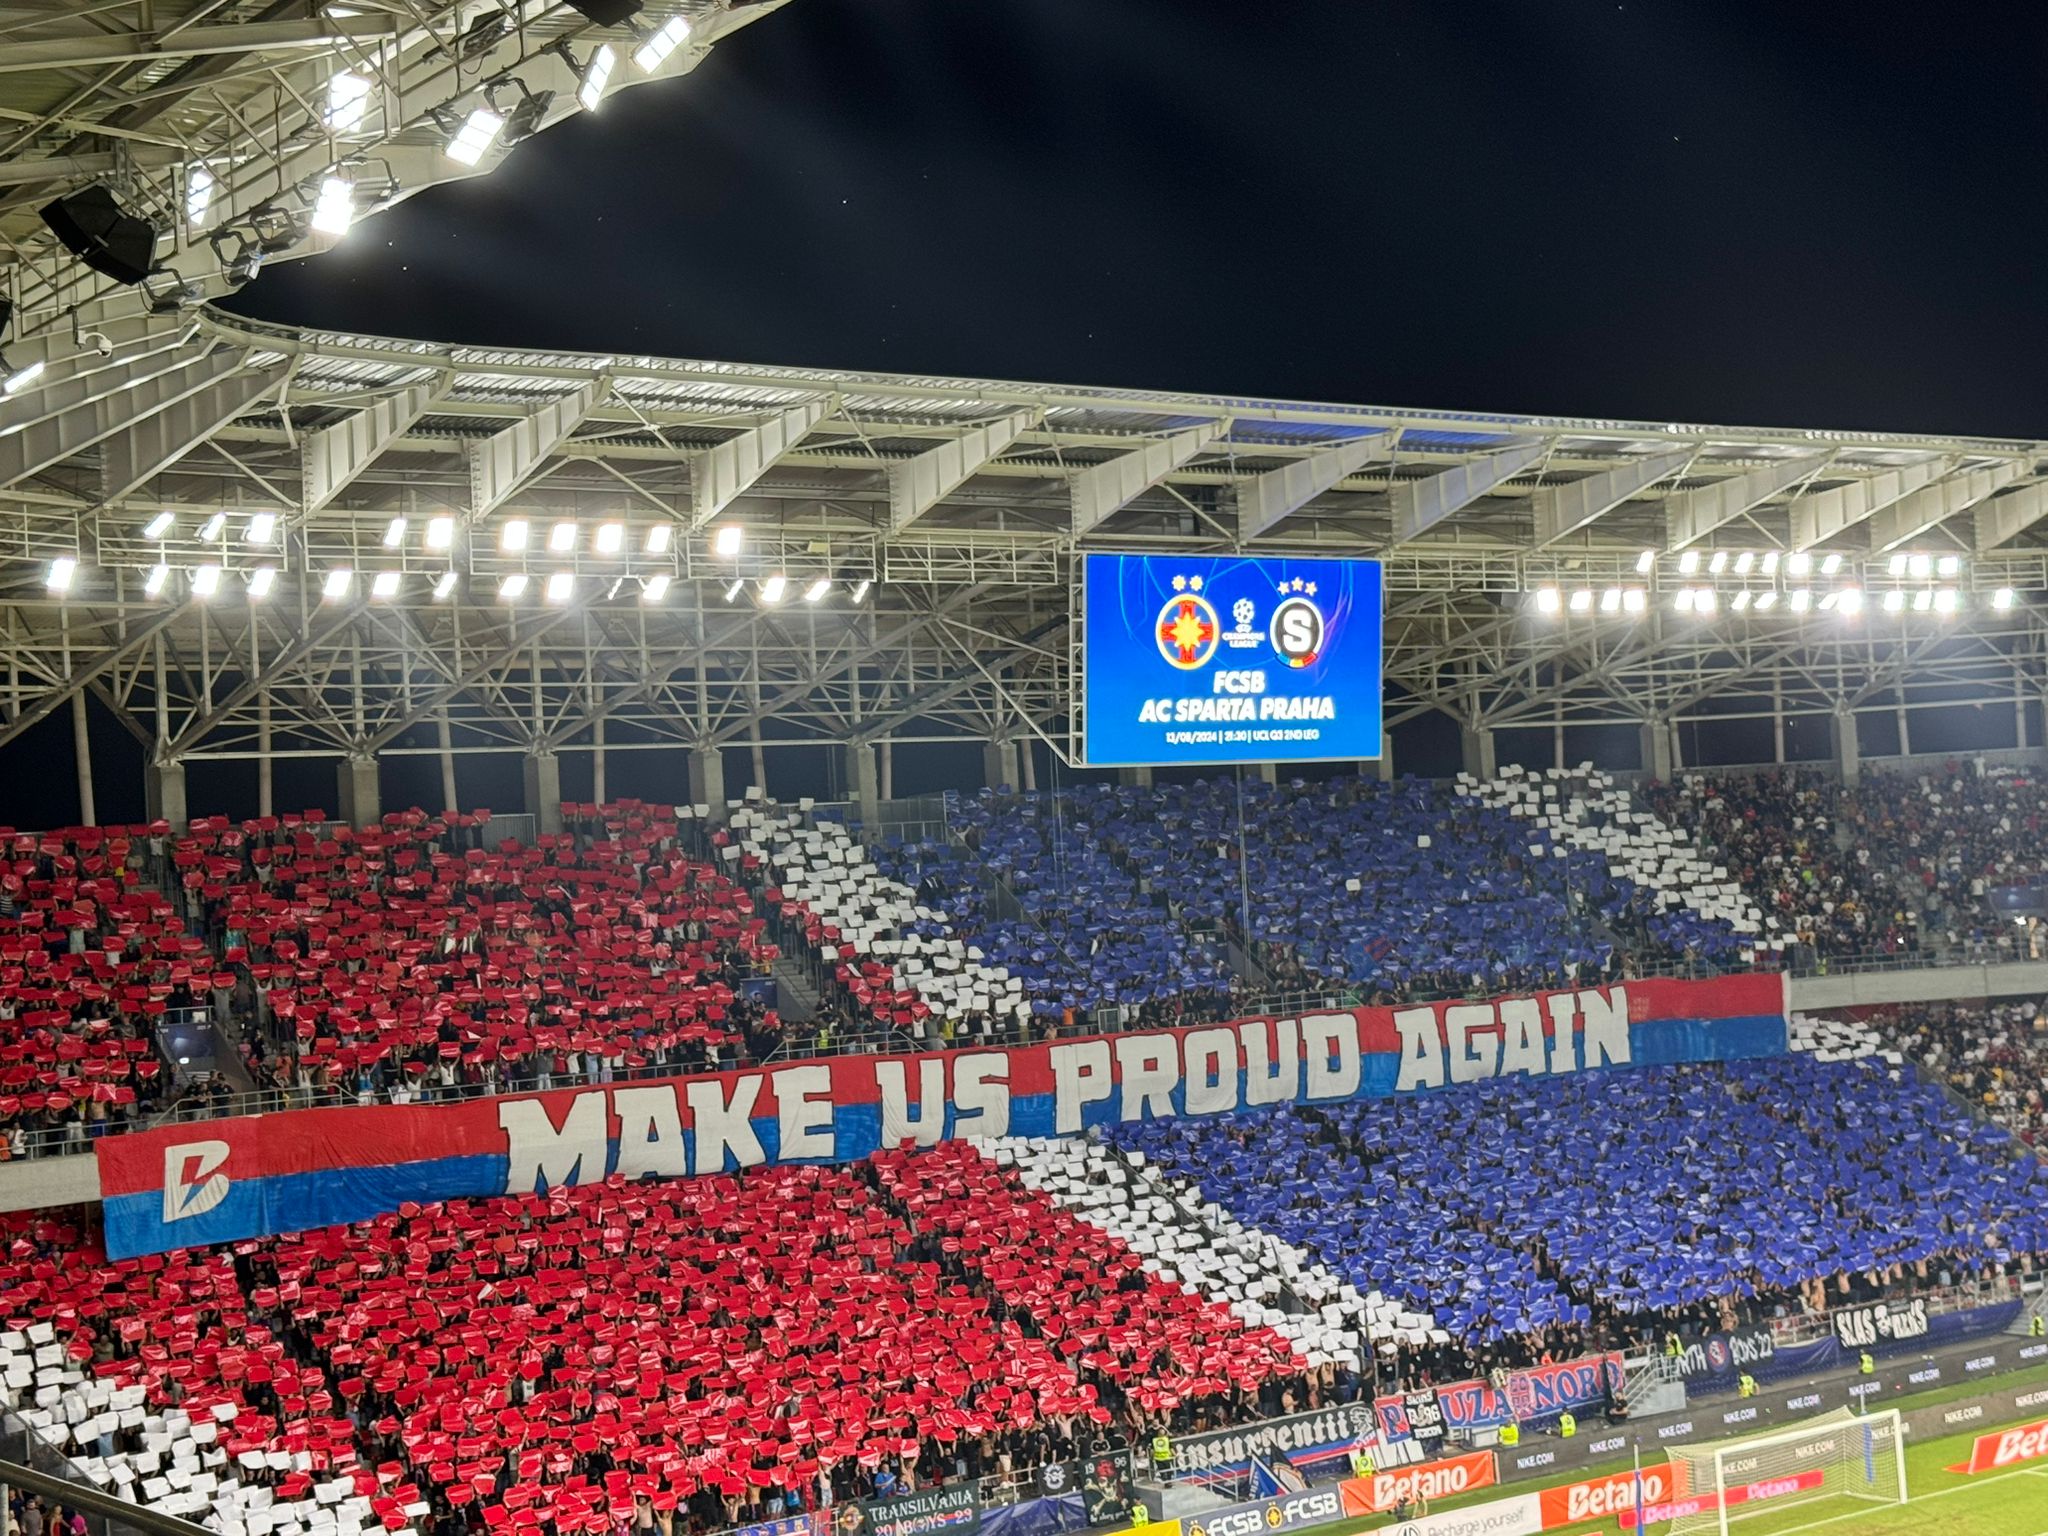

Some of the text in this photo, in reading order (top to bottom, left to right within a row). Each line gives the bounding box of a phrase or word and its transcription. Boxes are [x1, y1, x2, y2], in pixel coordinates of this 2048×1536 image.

[1213, 671, 1265, 693] FCSB
[1138, 696, 1335, 722] AC SPARTA PRAHA
[498, 984, 1631, 1196] MAKE US PROUD AGAIN
[163, 1140, 231, 1223] B
[1530, 1360, 1620, 1409] NORD
[1849, 1381, 1881, 1396] NIKE.COM
[1787, 1394, 1820, 1410] NIKE.COM
[1723, 1407, 1757, 1424] NIKE.COM
[1944, 1405, 1983, 1424] NIKE.COM
[1658, 1421, 1693, 1438] NIKE.COM
[1871, 1422, 1911, 1441] NIKE.CM
[1589, 1436, 1626, 1454] NIKE.COM
[1795, 1439, 1836, 1459] NIKE.COM
[1084, 1456, 1127, 1475] 19 96
[1517, 1452, 1555, 1470] NIKE.COM
[1373, 1465, 1468, 1508] Betano
[868, 1489, 974, 1522] TRANSILVANIA
[1567, 1475, 1663, 1520] Betano
[954, 1508, 973, 1524] 23
[1284, 1493, 1338, 1523] FCSB
[1207, 1509, 1263, 1536] FCSB
